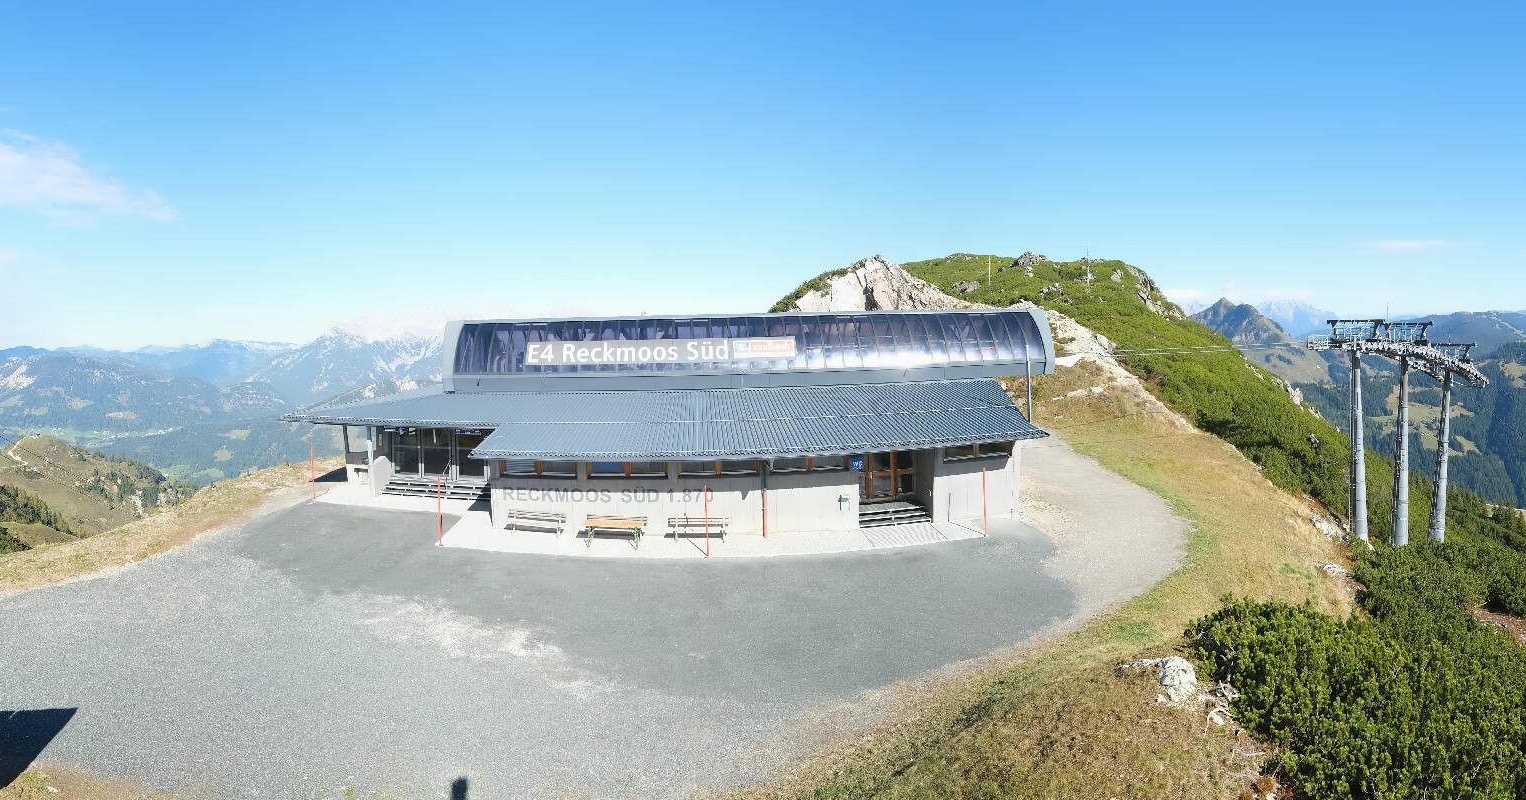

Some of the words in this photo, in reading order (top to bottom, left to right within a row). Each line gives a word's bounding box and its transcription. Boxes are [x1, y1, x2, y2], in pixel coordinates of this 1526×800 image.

[527, 344, 554, 363] E4
[562, 341, 678, 363] Reckmoos
[686, 340, 728, 360] Süd
[503, 487, 612, 503] RECKMOOS
[620, 486, 660, 503] SÜD
[666, 487, 714, 503] 1.870
